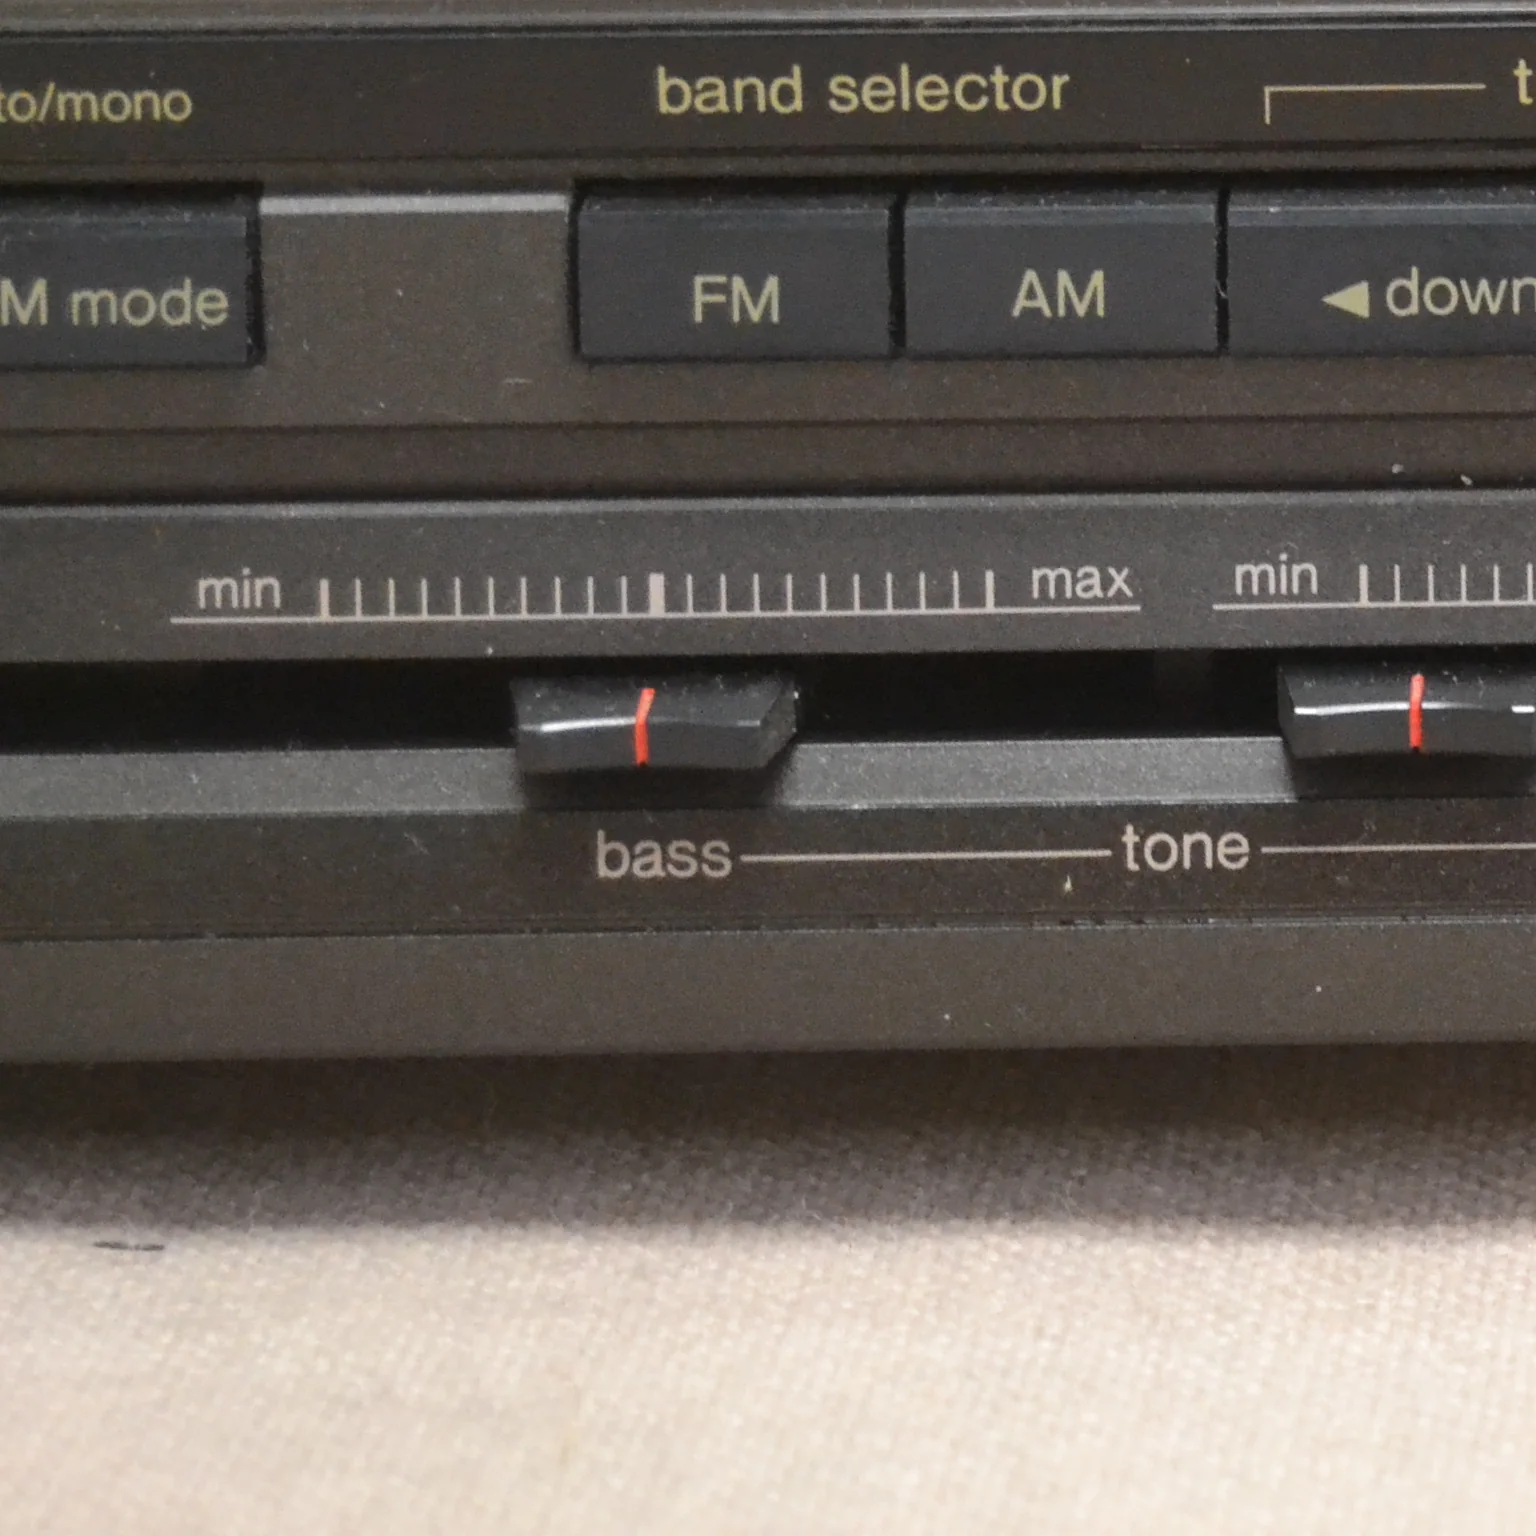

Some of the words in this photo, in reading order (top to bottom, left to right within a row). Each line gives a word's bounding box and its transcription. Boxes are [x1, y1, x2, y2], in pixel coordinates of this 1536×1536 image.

[0, 82, 193, 123] o/mono
[657, 64, 803, 115] band
[828, 63, 1070, 113] selector
[70, 277, 229, 327] mode
[693, 274, 780, 323] FM
[1012, 269, 1105, 318] AM
[197, 567, 282, 609] min
[1031, 565, 1134, 599] max
[1235, 552, 1318, 596] min
[596, 830, 732, 880] bass
[1121, 823, 1250, 872] tone
